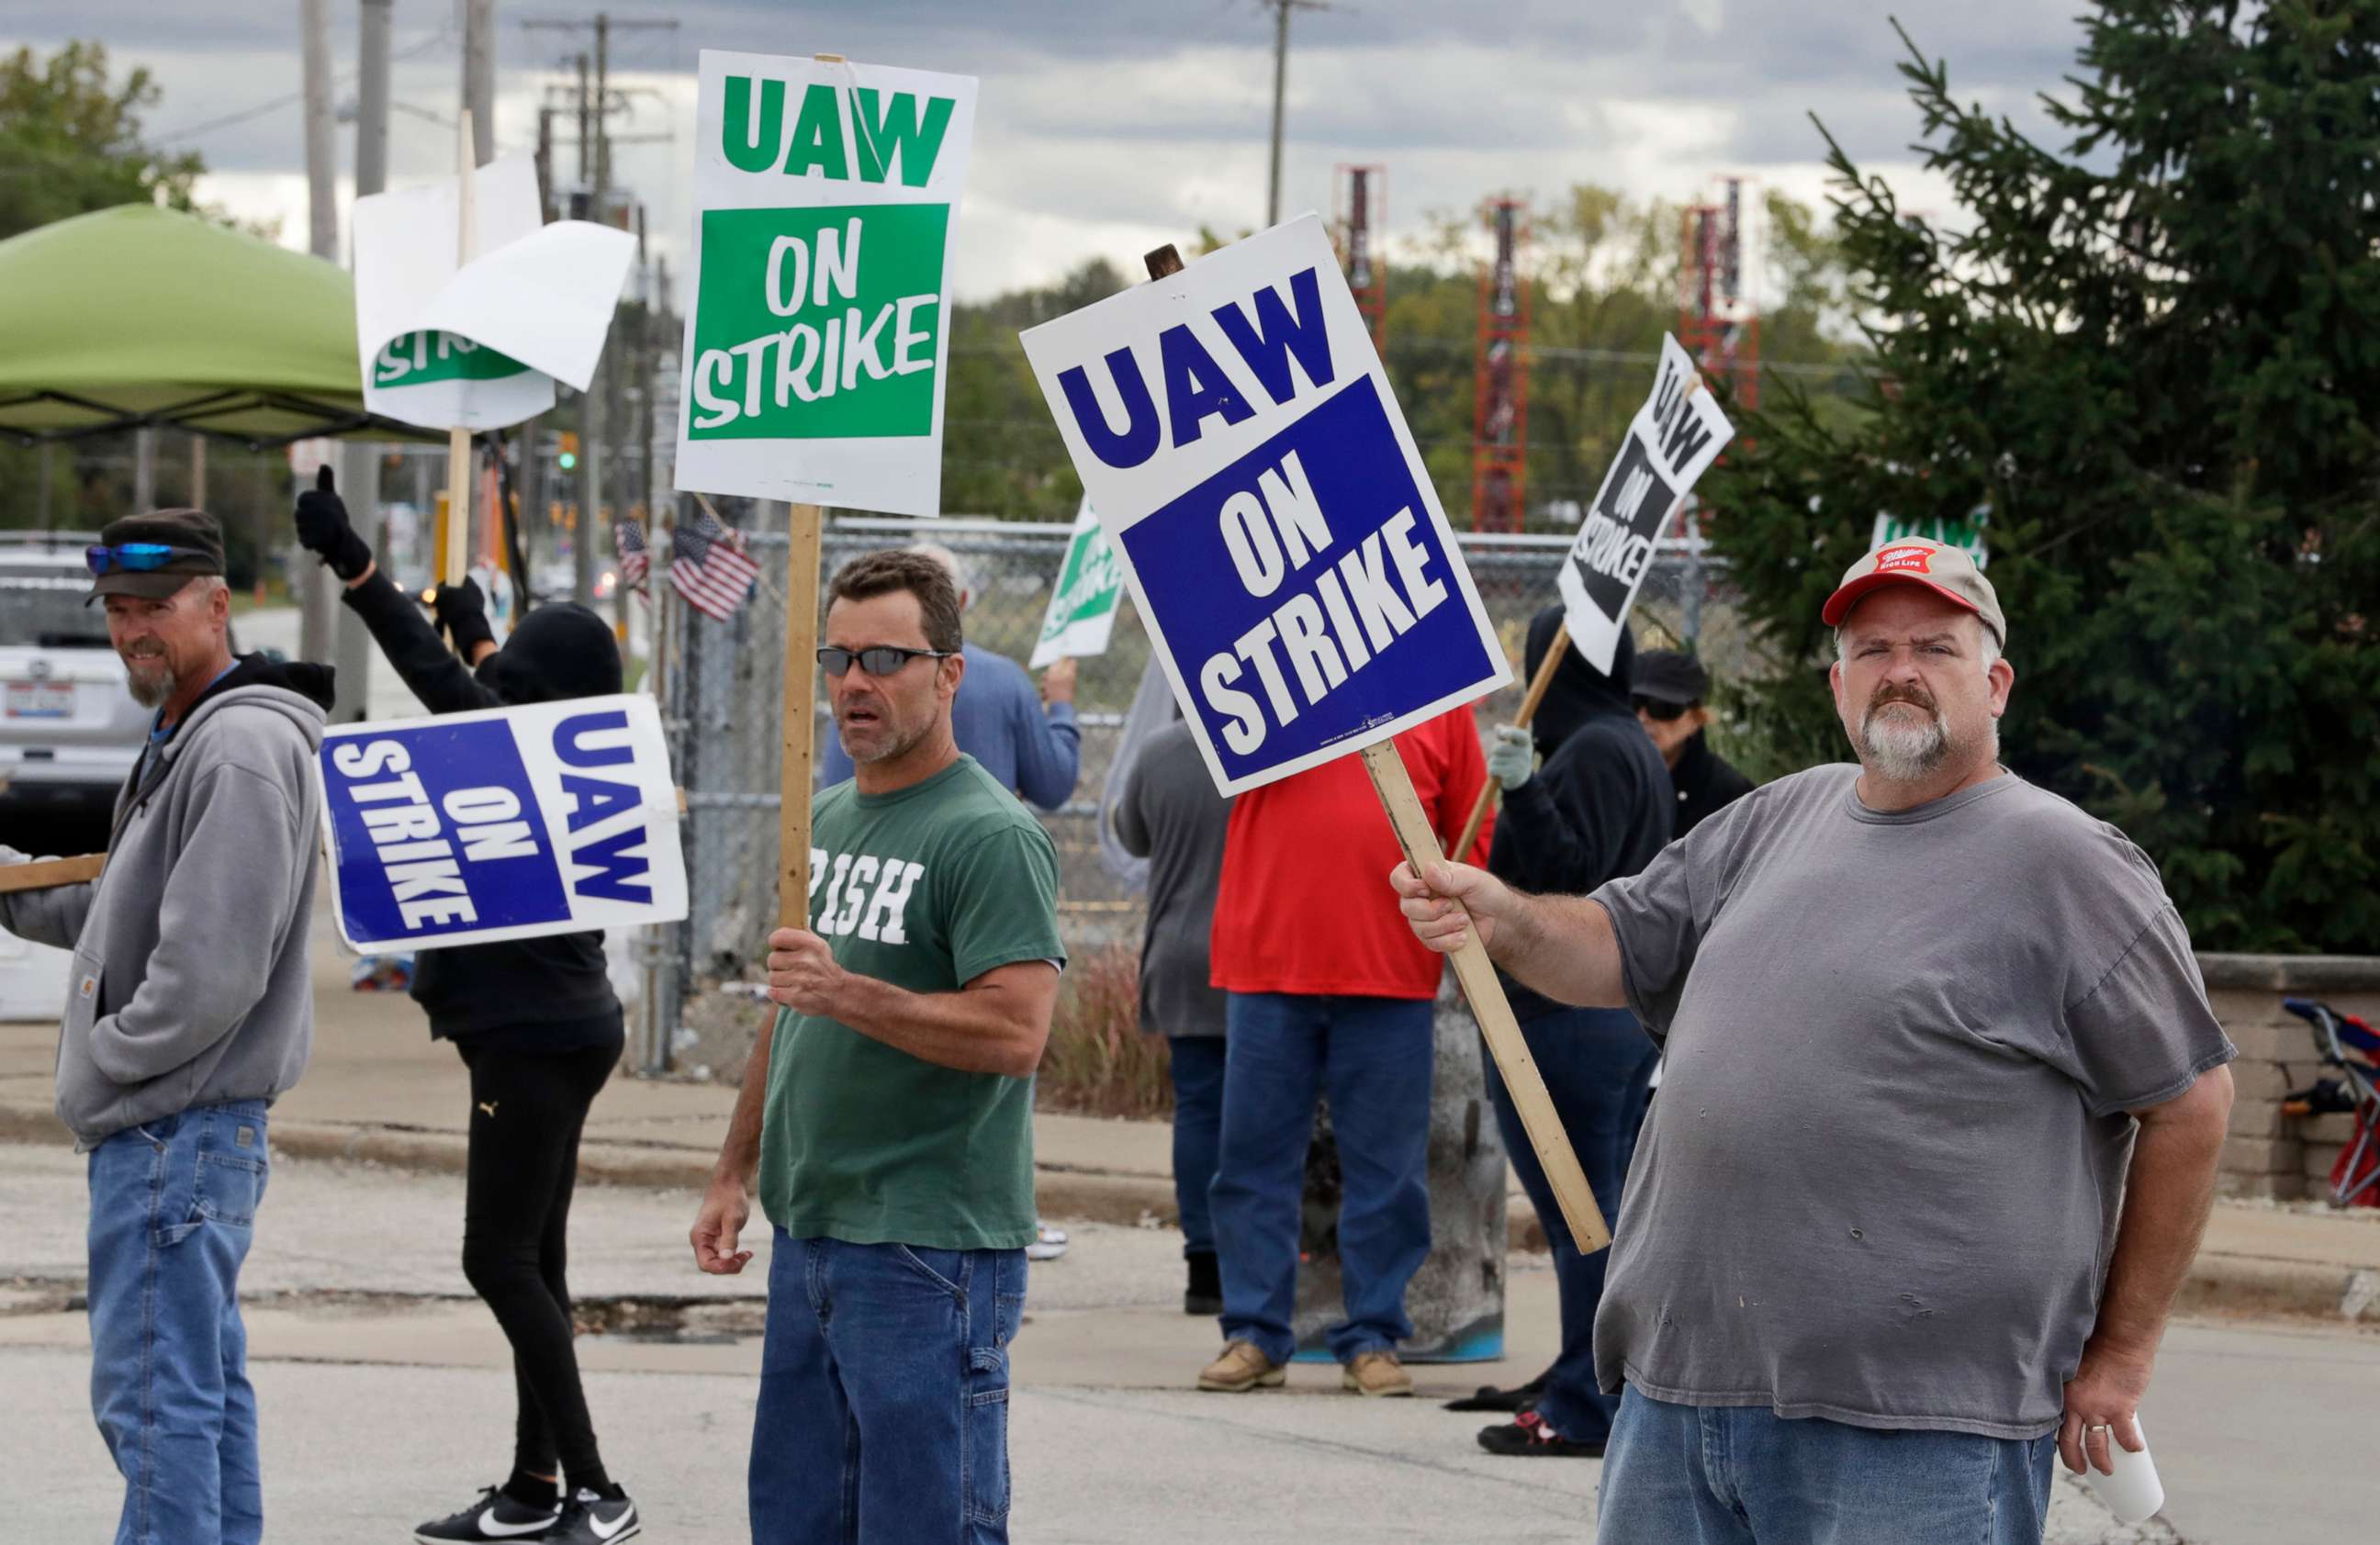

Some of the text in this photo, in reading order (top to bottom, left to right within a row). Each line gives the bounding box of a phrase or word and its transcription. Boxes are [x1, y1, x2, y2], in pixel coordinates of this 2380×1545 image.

[722, 75, 957, 188] UAW
[765, 217, 863, 317] ON
[693, 293, 938, 429] STRIKE
[1056, 265, 1336, 469] UAW
[1653, 357, 1712, 476] UAW
[1218, 448, 1334, 597] ON
[1574, 509, 1652, 587] STRIKE
[1613, 464, 1654, 522] ON
[1902, 559, 1921, 567] LIFE
[1200, 505, 1449, 756] STRIKE
[332, 739, 478, 931] STRIKE
[442, 785, 539, 862] ON
[552, 709, 654, 904] UAW
